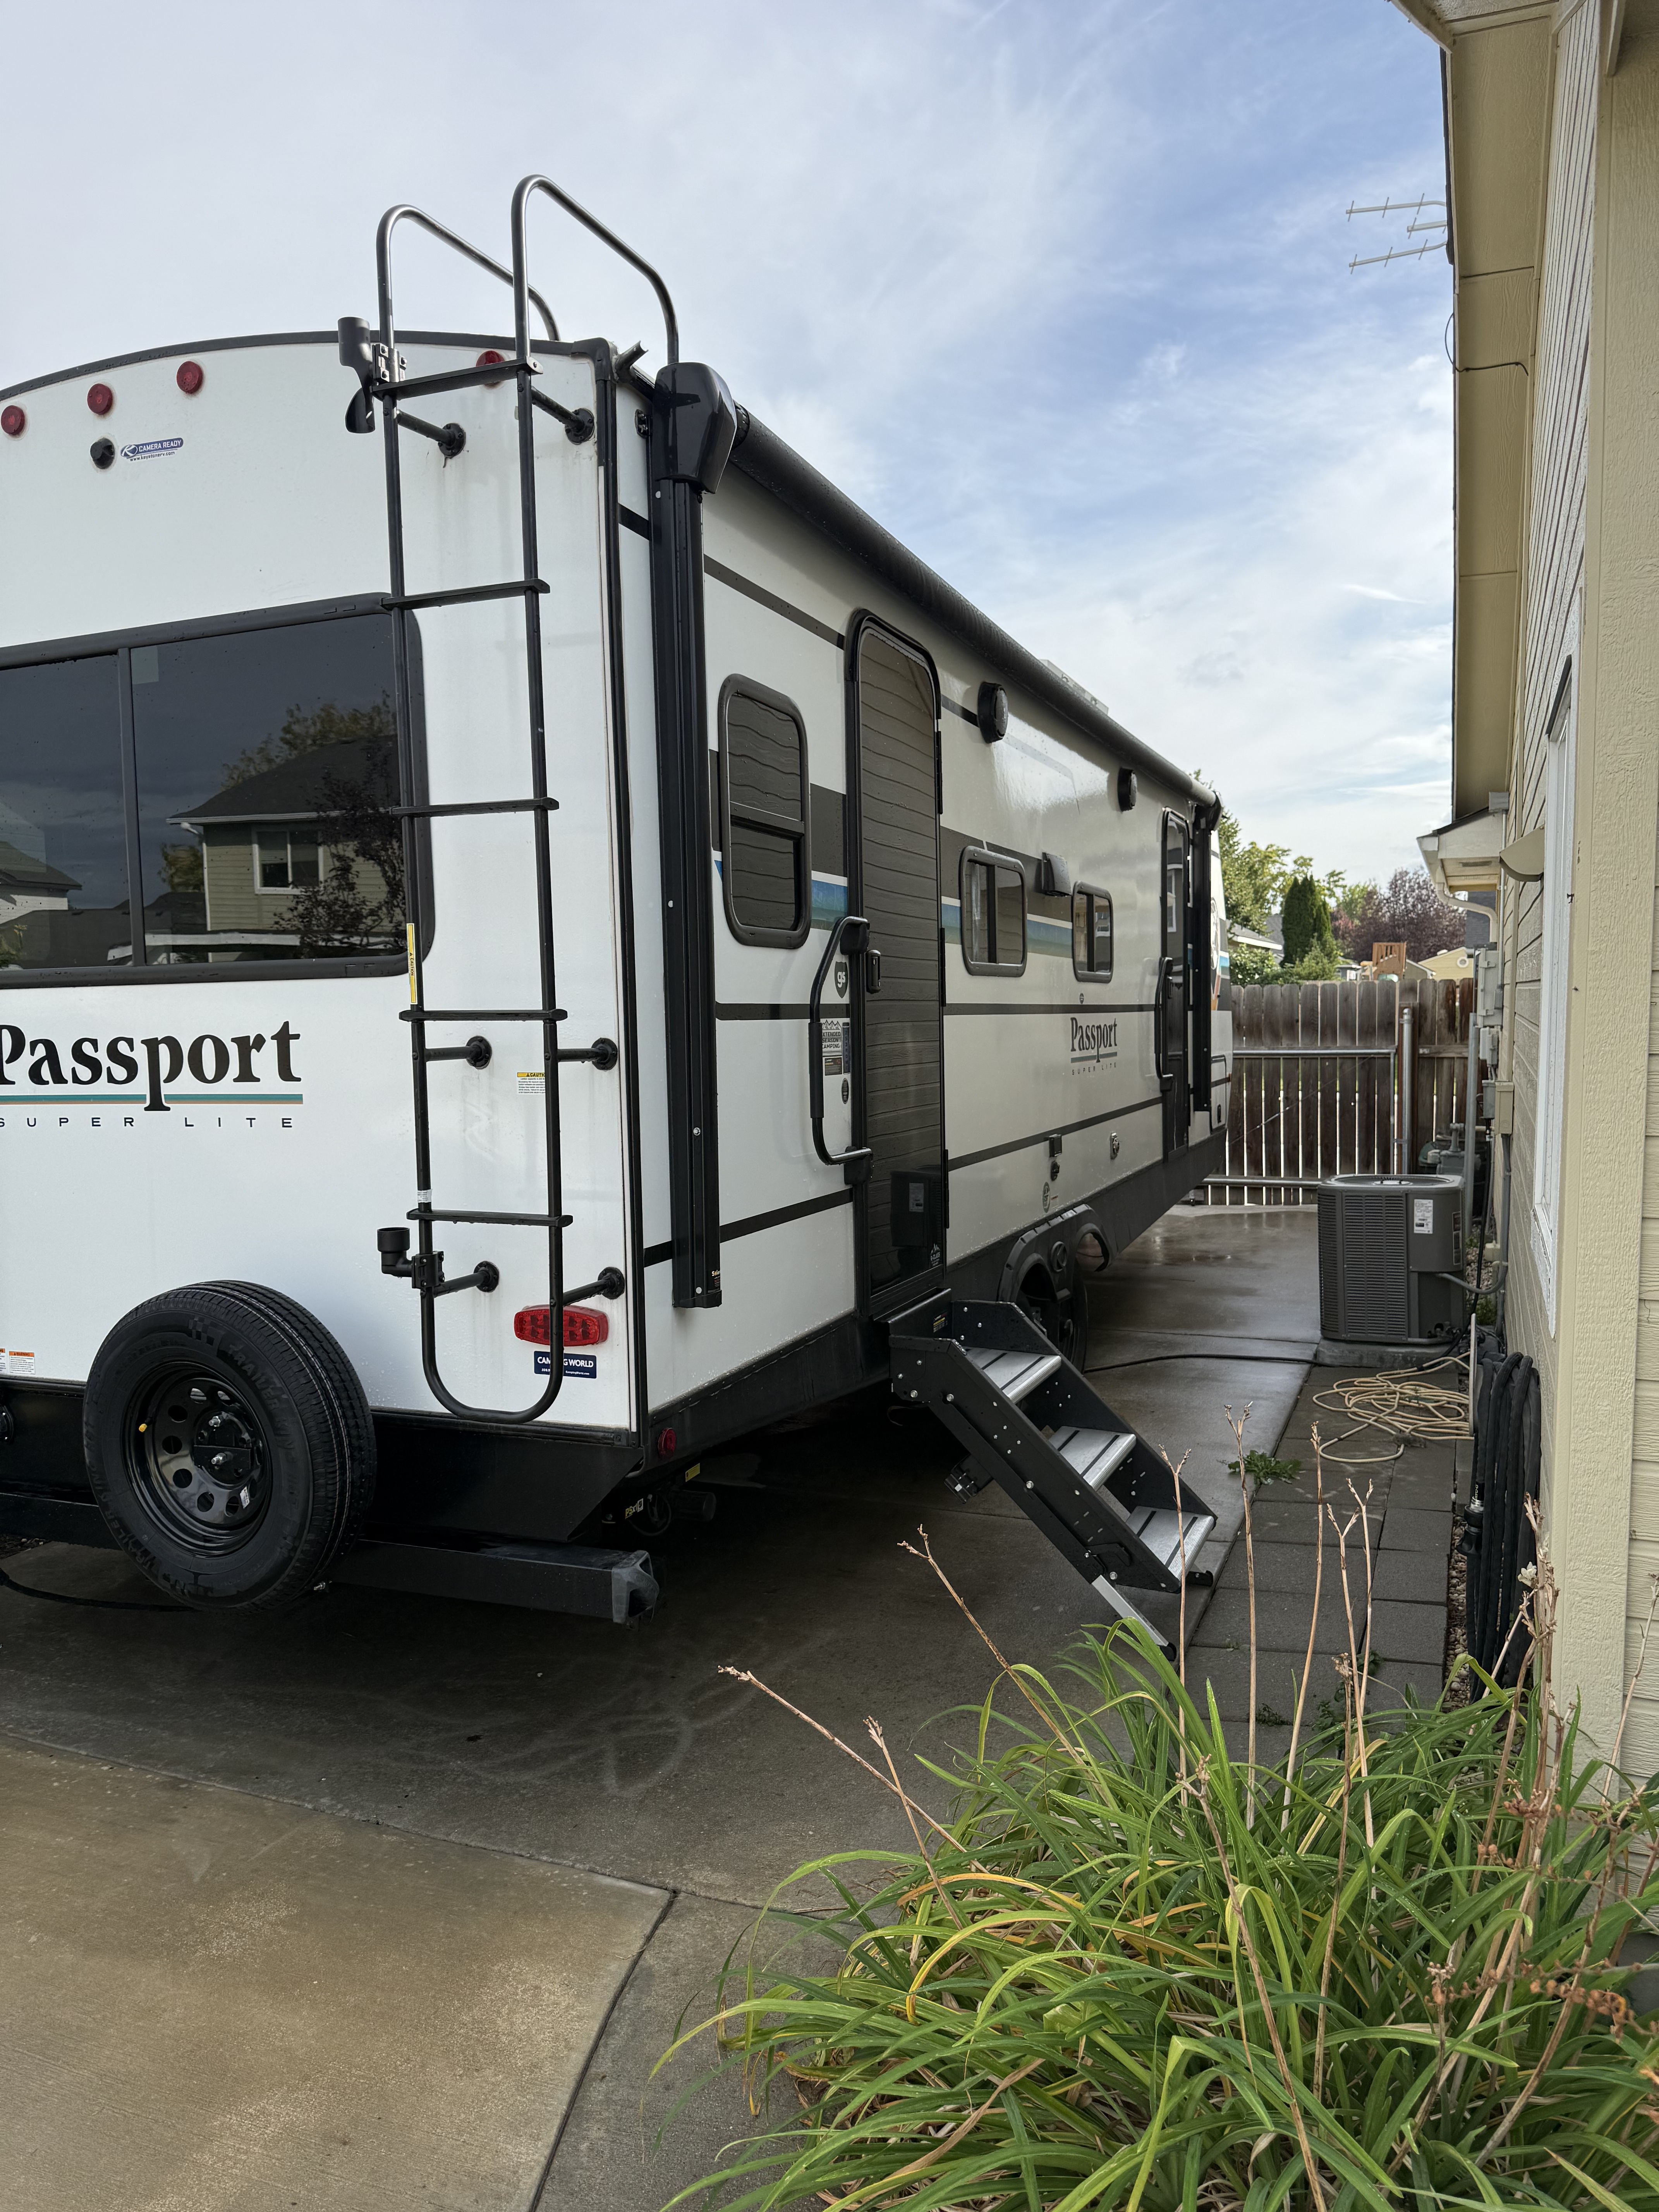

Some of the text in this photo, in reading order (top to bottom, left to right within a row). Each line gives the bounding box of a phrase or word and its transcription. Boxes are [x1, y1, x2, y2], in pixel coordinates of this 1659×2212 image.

[139, 440, 181, 452] CAMERA READY
[130, 451, 175, 462] www.keystonerv.com
[837, 971, 846, 988] gs
[1070, 1017, 1117, 1063] Passport
[0, 1021, 301, 1111] Passport
[1072, 1066, 1095, 1075] SUPER
[185, 1117, 292, 1128] LITE
[538, 1357, 594, 1368] CAMG WORLD
[226, 1343, 281, 1411] TRAILER
[104, 1508, 154, 1571] TRAILER
